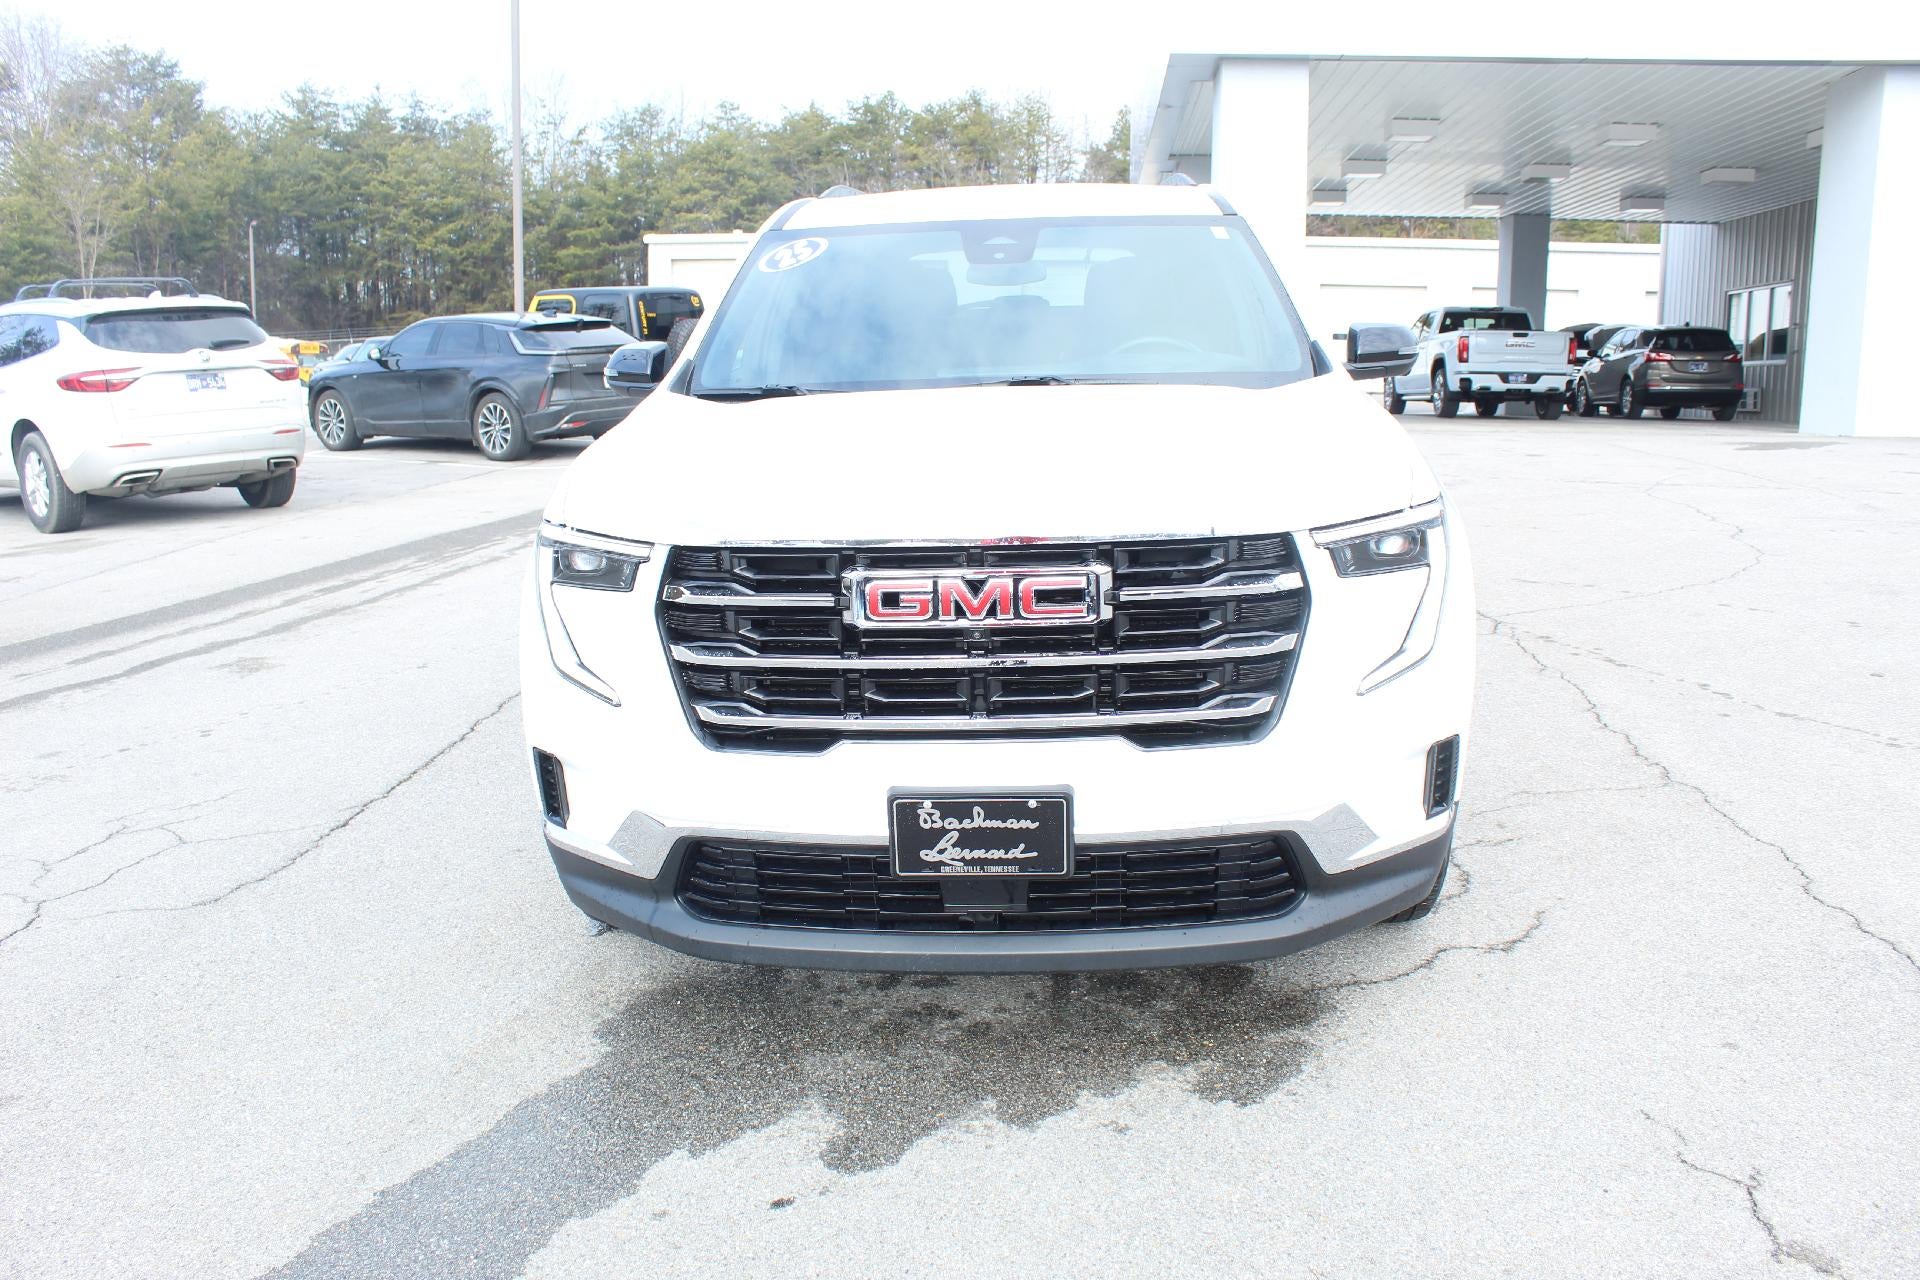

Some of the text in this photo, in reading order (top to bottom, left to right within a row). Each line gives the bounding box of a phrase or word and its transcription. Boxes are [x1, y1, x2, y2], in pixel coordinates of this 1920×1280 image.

[773, 240, 814, 268] 25
[865, 576, 1088, 621] GMC
[917, 806, 1039, 830] Bachman
[940, 865, 1020, 874] GREENEVILLE, TENNESSEE
